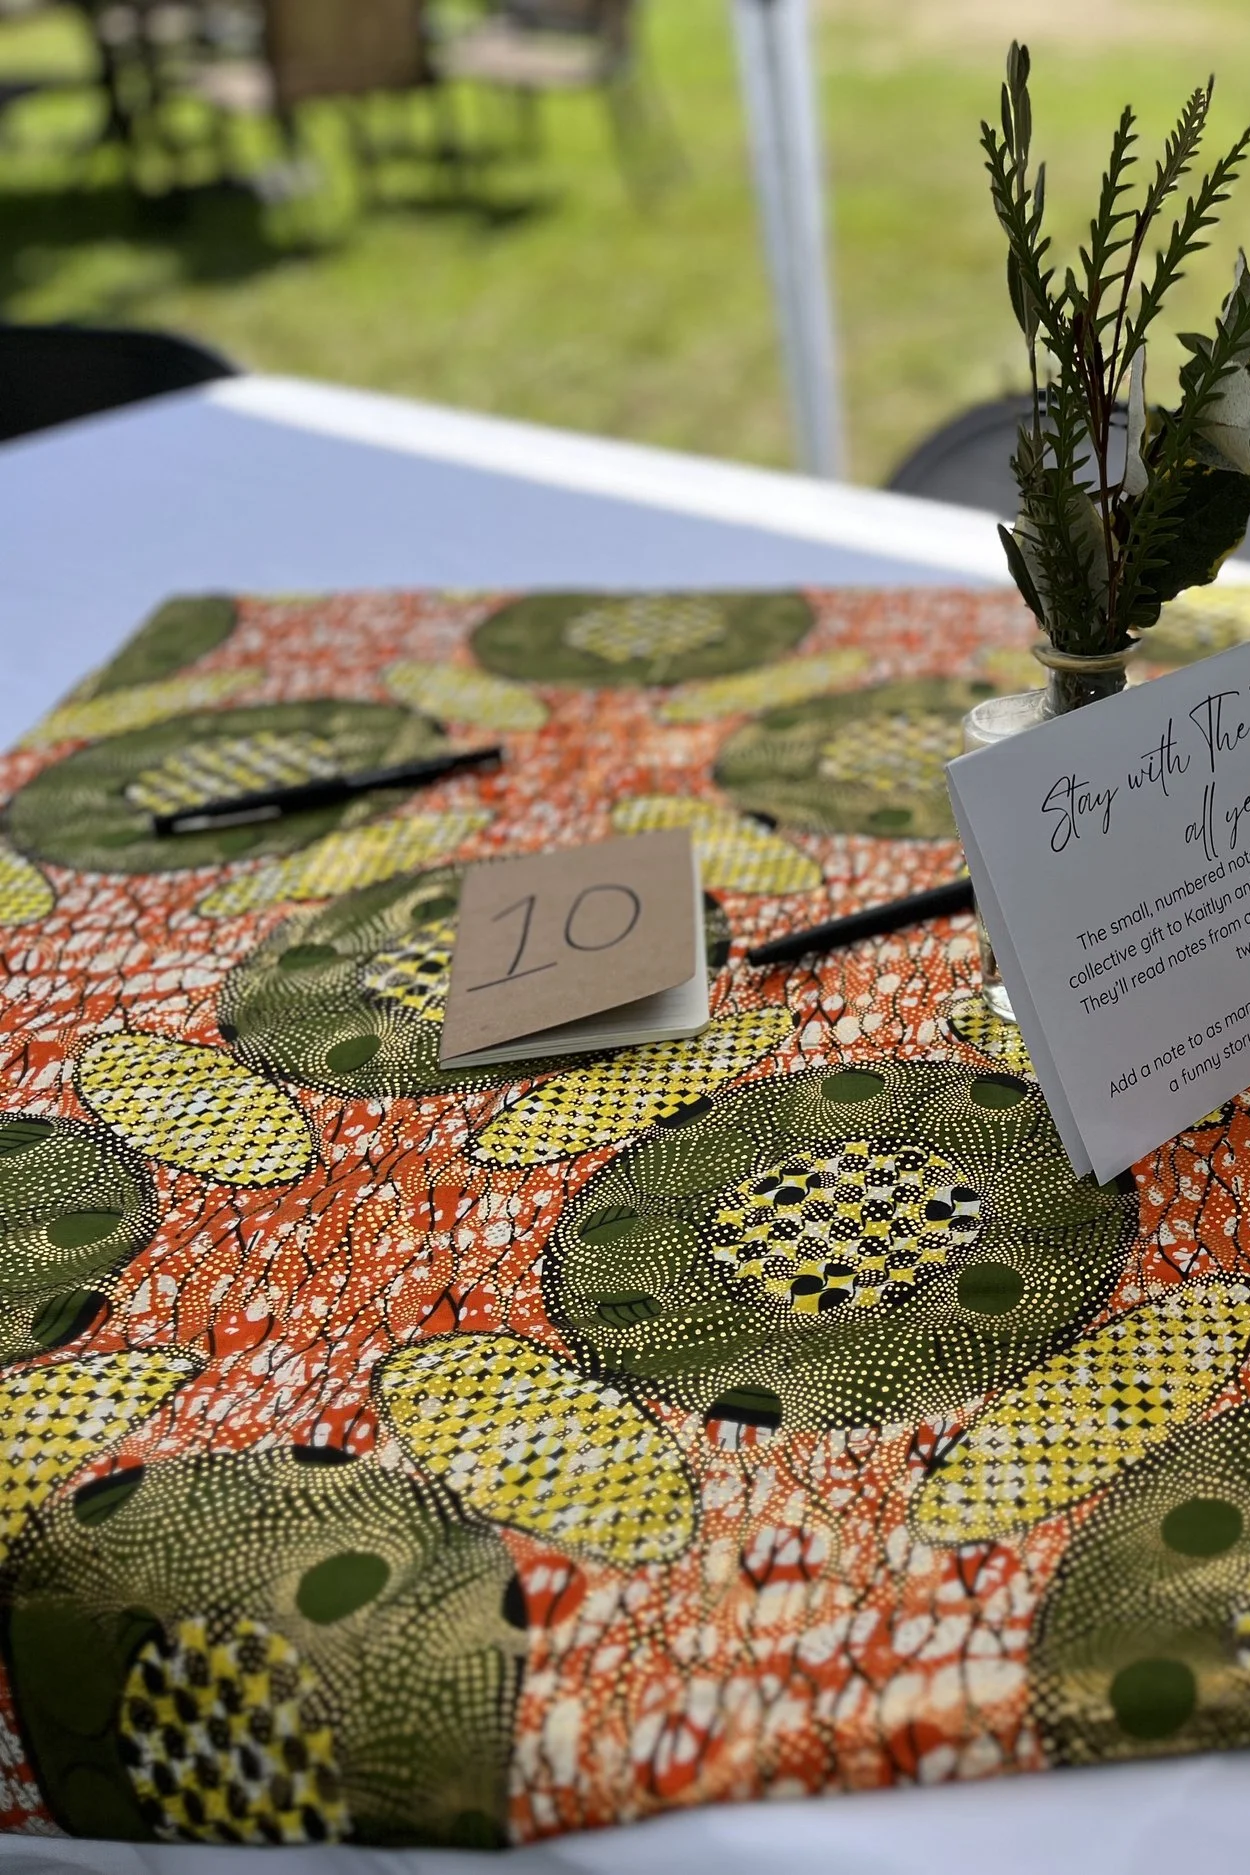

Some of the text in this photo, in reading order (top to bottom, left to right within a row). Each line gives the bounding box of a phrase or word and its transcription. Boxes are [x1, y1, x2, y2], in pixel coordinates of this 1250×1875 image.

[1040, 773, 1120, 853] Stay
[1127, 717, 1191, 797] with
[1188, 690, 1250, 774] The
[1184, 780, 1220, 862] all
[466, 883, 641, 993] 10
[1068, 944, 1138, 989] collective
[1140, 926, 1166, 955] gift
[1163, 920, 1183, 937] to
[1183, 892, 1233, 927] Kaitlyn
[1075, 927, 1108, 951] The
[1109, 900, 1154, 935] small,
[1154, 860, 1227, 913] numbered
[1130, 955, 1166, 989] read
[1167, 937, 1207, 969] notes
[1206, 918, 1242, 945] from
[1110, 1067, 1139, 1099] Add
[1140, 1063, 1152, 1078] a
[1153, 1043, 1187, 1072] note
[1187, 1033, 1204, 1050] to
[1205, 1020, 1223, 1039] as
[1169, 1078, 1180, 1093] a
[1179, 1052, 1222, 1085] funny
